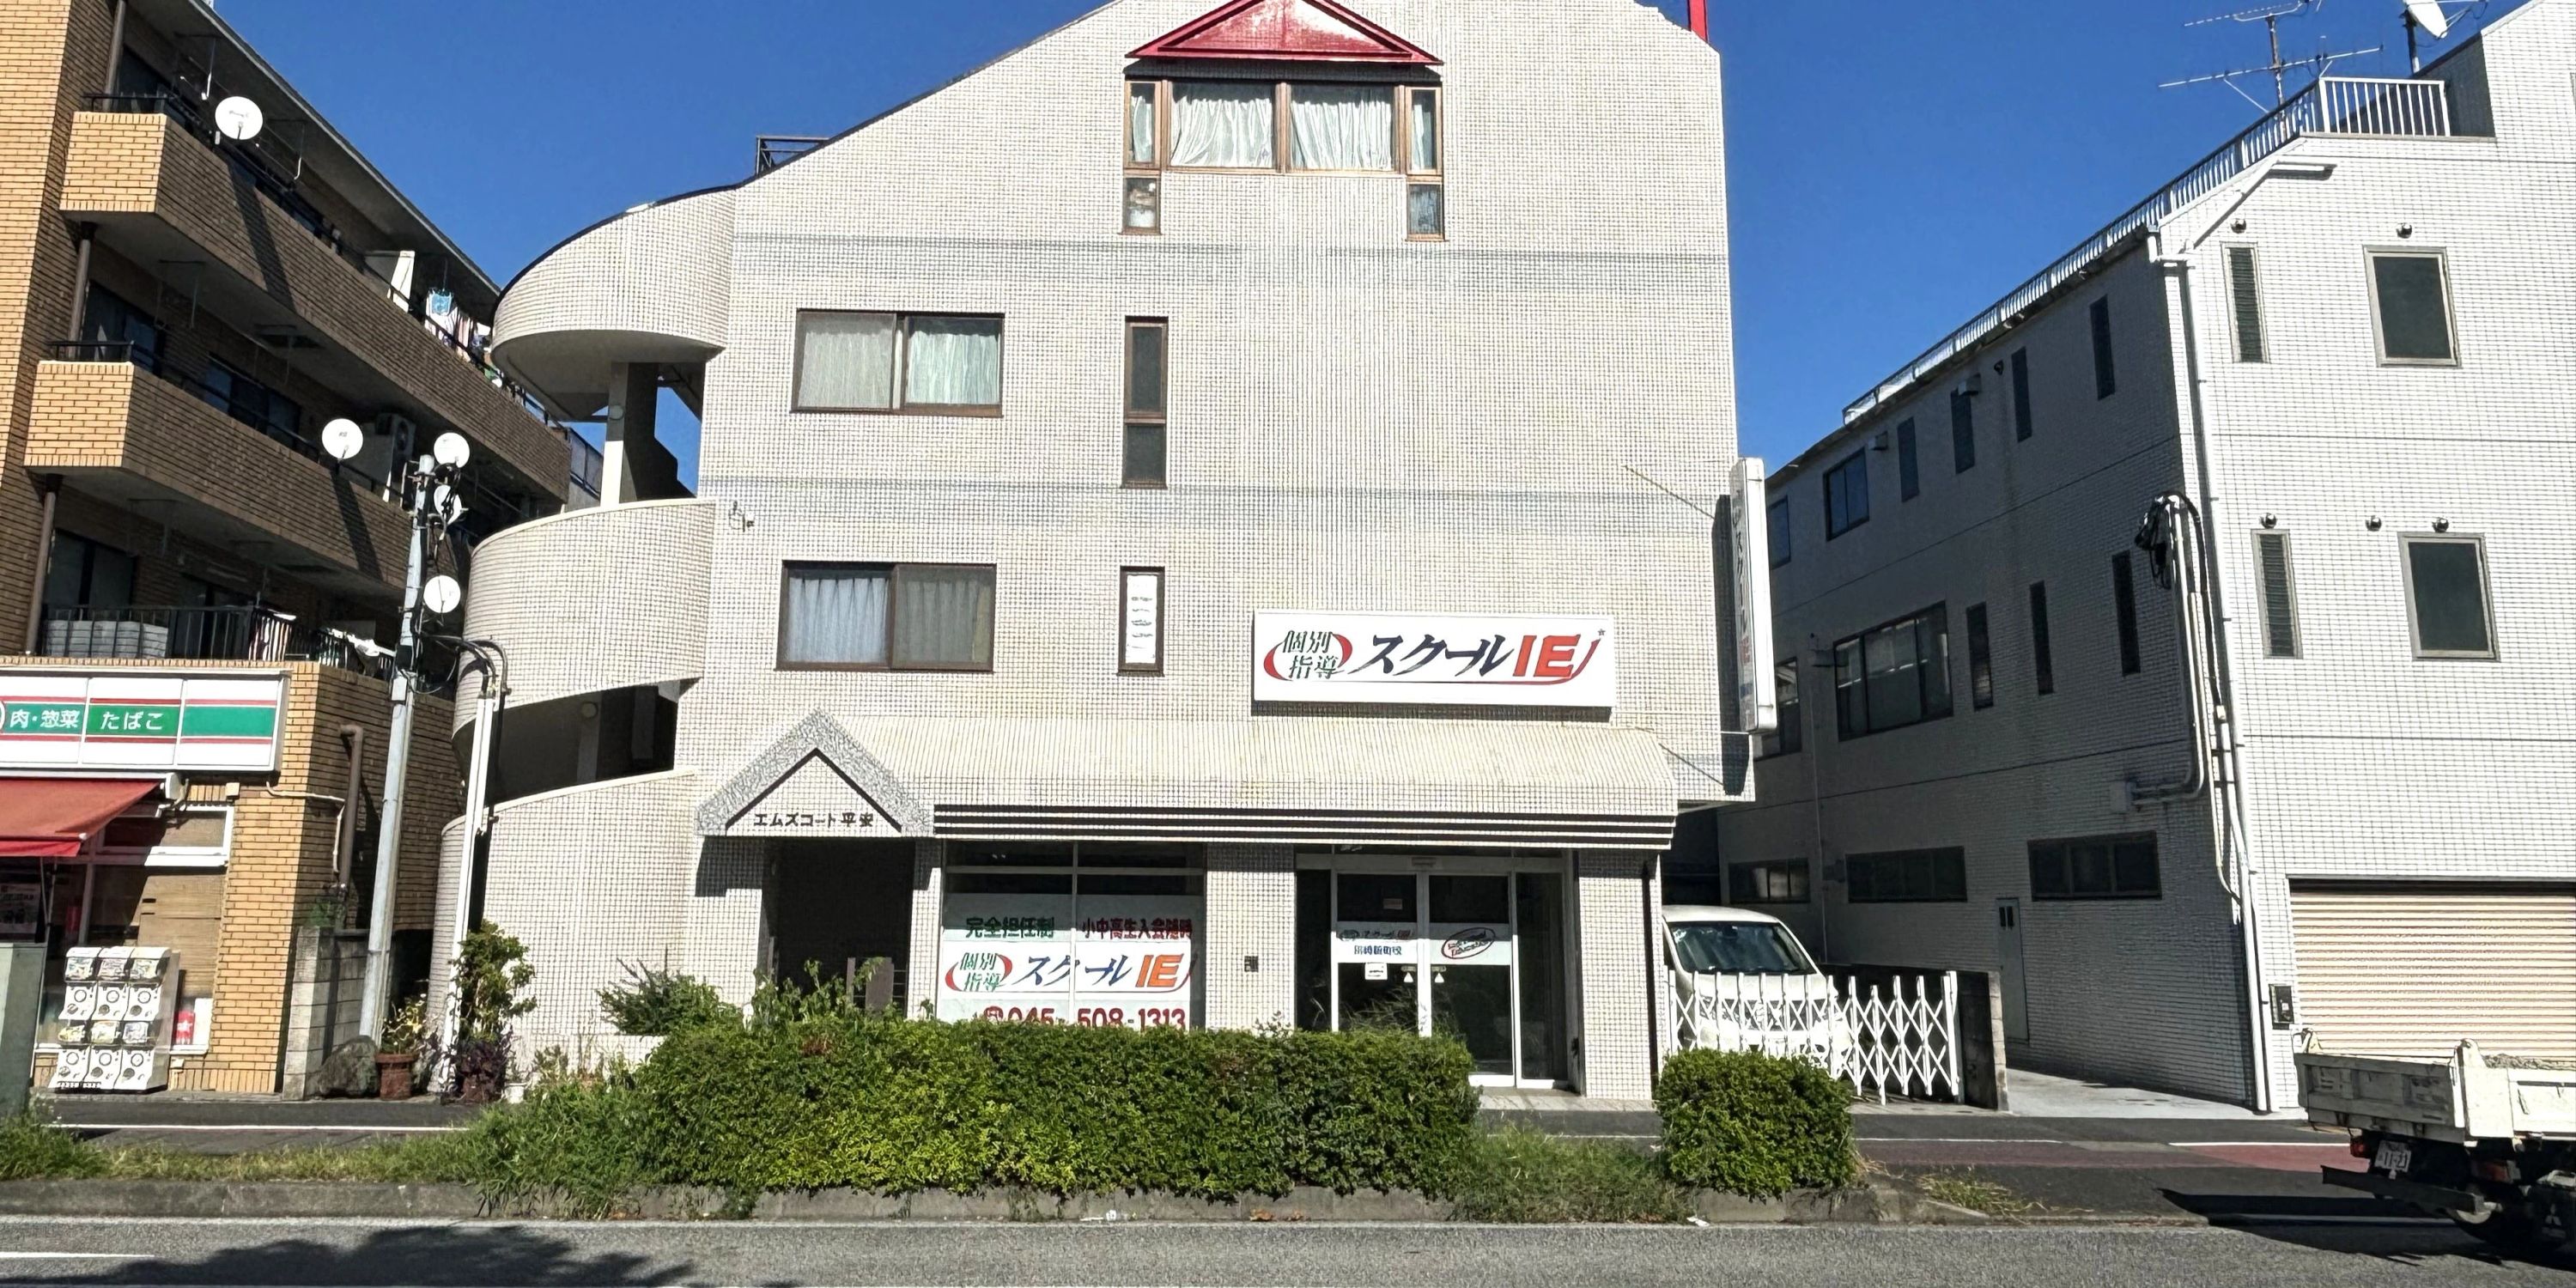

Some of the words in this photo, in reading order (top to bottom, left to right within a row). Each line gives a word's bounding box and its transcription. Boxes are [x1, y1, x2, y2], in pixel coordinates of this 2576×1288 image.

[1282, 630, 1334, 653] 個別
[1347, 634, 1581, 677] スクールIE
[1288, 655, 1342, 679] 指導
[10, 708, 81, 728] 肉・惣菜
[100, 711, 163, 730] たばこ
[965, 916, 1055, 938] 完全担任制
